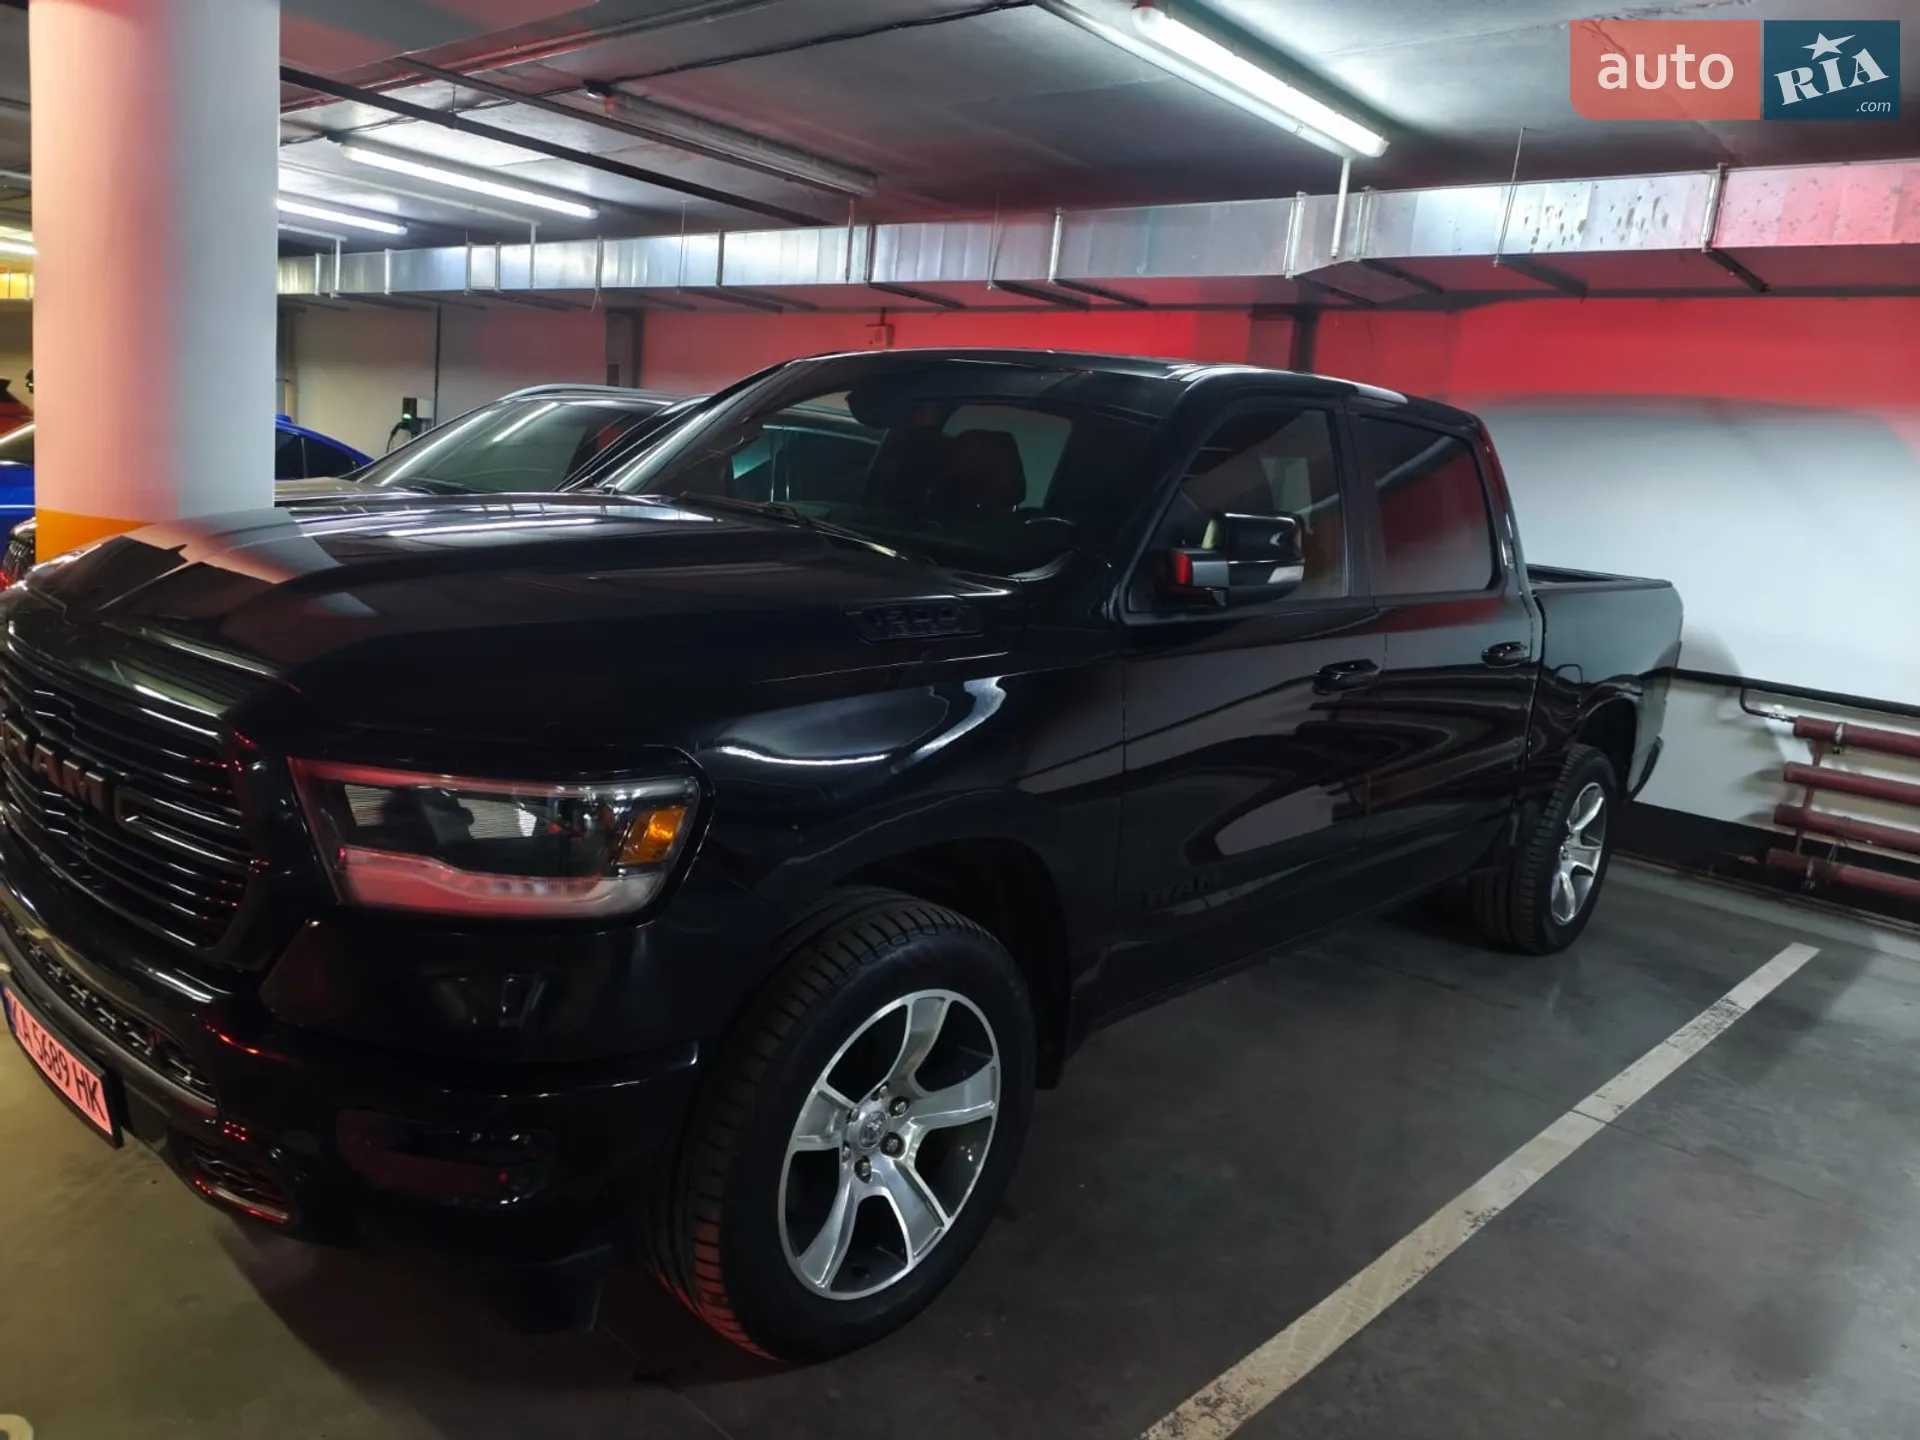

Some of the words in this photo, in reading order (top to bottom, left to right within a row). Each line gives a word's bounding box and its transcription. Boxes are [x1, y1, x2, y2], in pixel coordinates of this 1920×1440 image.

[4, 718, 107, 813] RAM
[31, 1020, 70, 1088] 5689
[72, 1060, 107, 1122] HK
